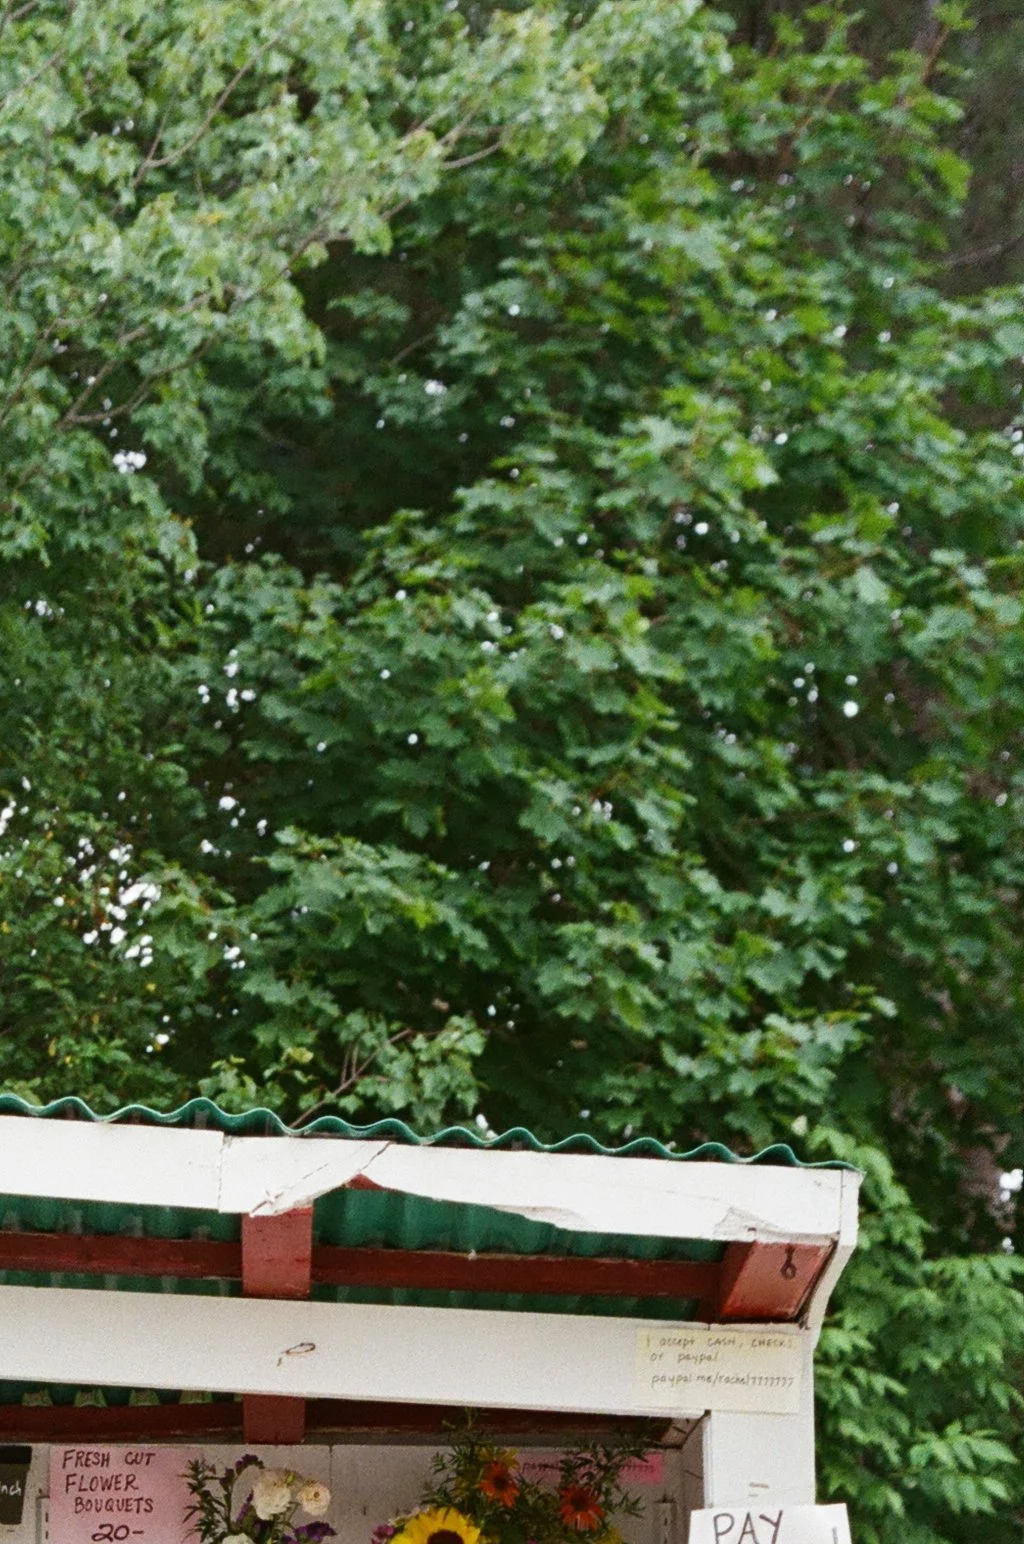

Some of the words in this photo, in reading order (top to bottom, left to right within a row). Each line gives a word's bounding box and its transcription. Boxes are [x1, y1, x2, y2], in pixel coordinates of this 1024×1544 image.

[659, 1337, 695, 1349] accept
[677, 1351, 719, 1365] paypal
[62, 1449, 111, 1469] FRESH
[124, 1451, 156, 1466] CUT
[65, 1473, 139, 1493] FLOWER
[74, 1496, 154, 1514] BOUQUETS
